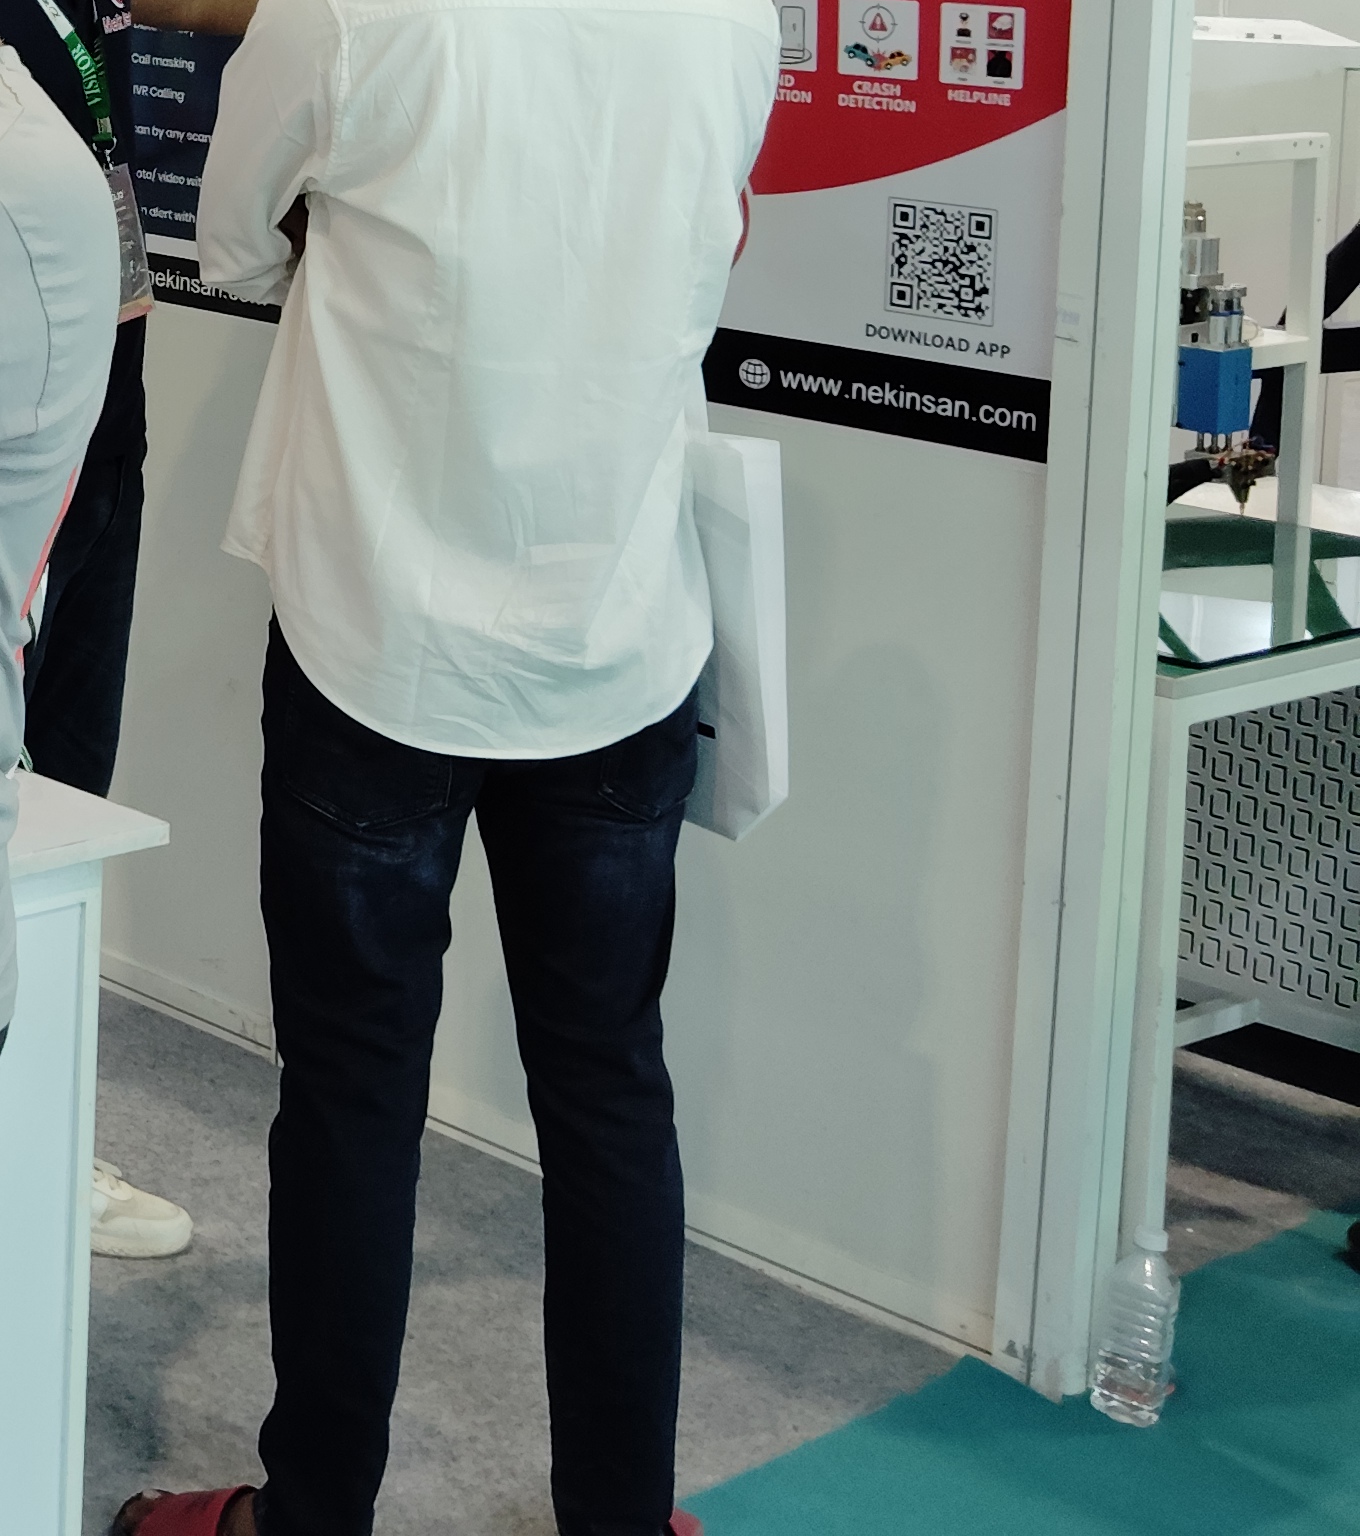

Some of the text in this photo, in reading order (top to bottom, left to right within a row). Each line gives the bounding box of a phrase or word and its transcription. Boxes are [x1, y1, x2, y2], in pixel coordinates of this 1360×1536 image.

[131, 52, 196, 72] Call masking
[149, 86, 185, 103] Calling
[852, 80, 901, 97] CRASH
[947, 89, 1012, 107] HELPLINE
[837, 93, 917, 114] DETECTION
[149, 207, 173, 220] alert
[865, 322, 1011, 359] DOWNLOAD APP
[780, 368, 1038, 432] www.nekinsan.com
